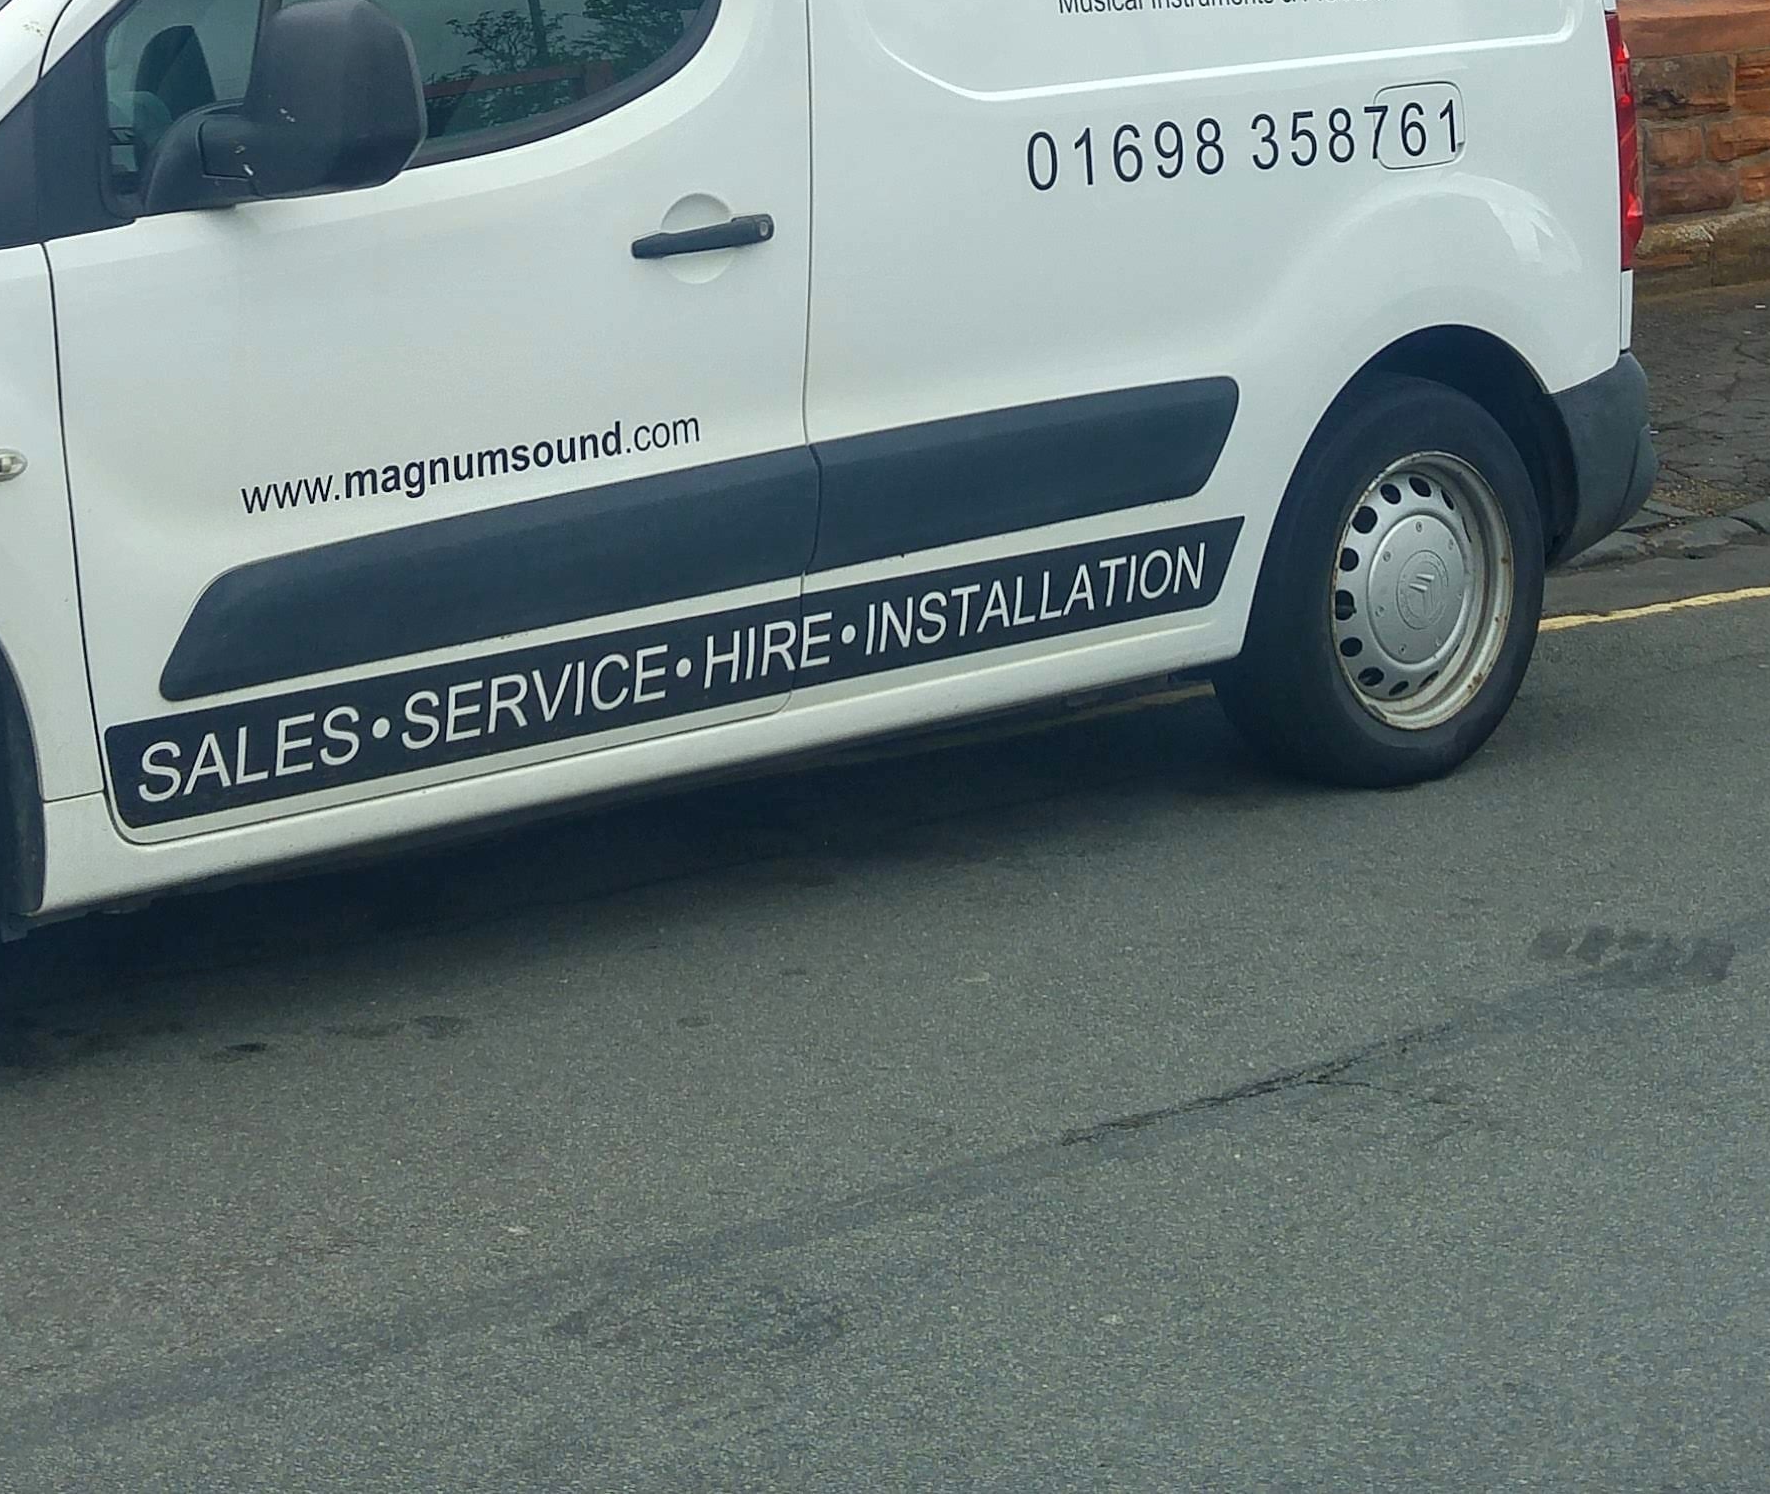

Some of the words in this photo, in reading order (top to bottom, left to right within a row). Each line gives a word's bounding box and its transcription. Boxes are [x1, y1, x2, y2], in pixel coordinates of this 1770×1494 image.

[1027, 117, 1225, 191] 01698
[1251, 99, 1459, 170] 358761
[241, 416, 700, 514] www.magnumsound.com
[137, 704, 361, 803] SALES
[400, 644, 669, 751] SERVICE
[704, 611, 833, 692] HIRE
[864, 540, 1207, 654] INSTALLATION
